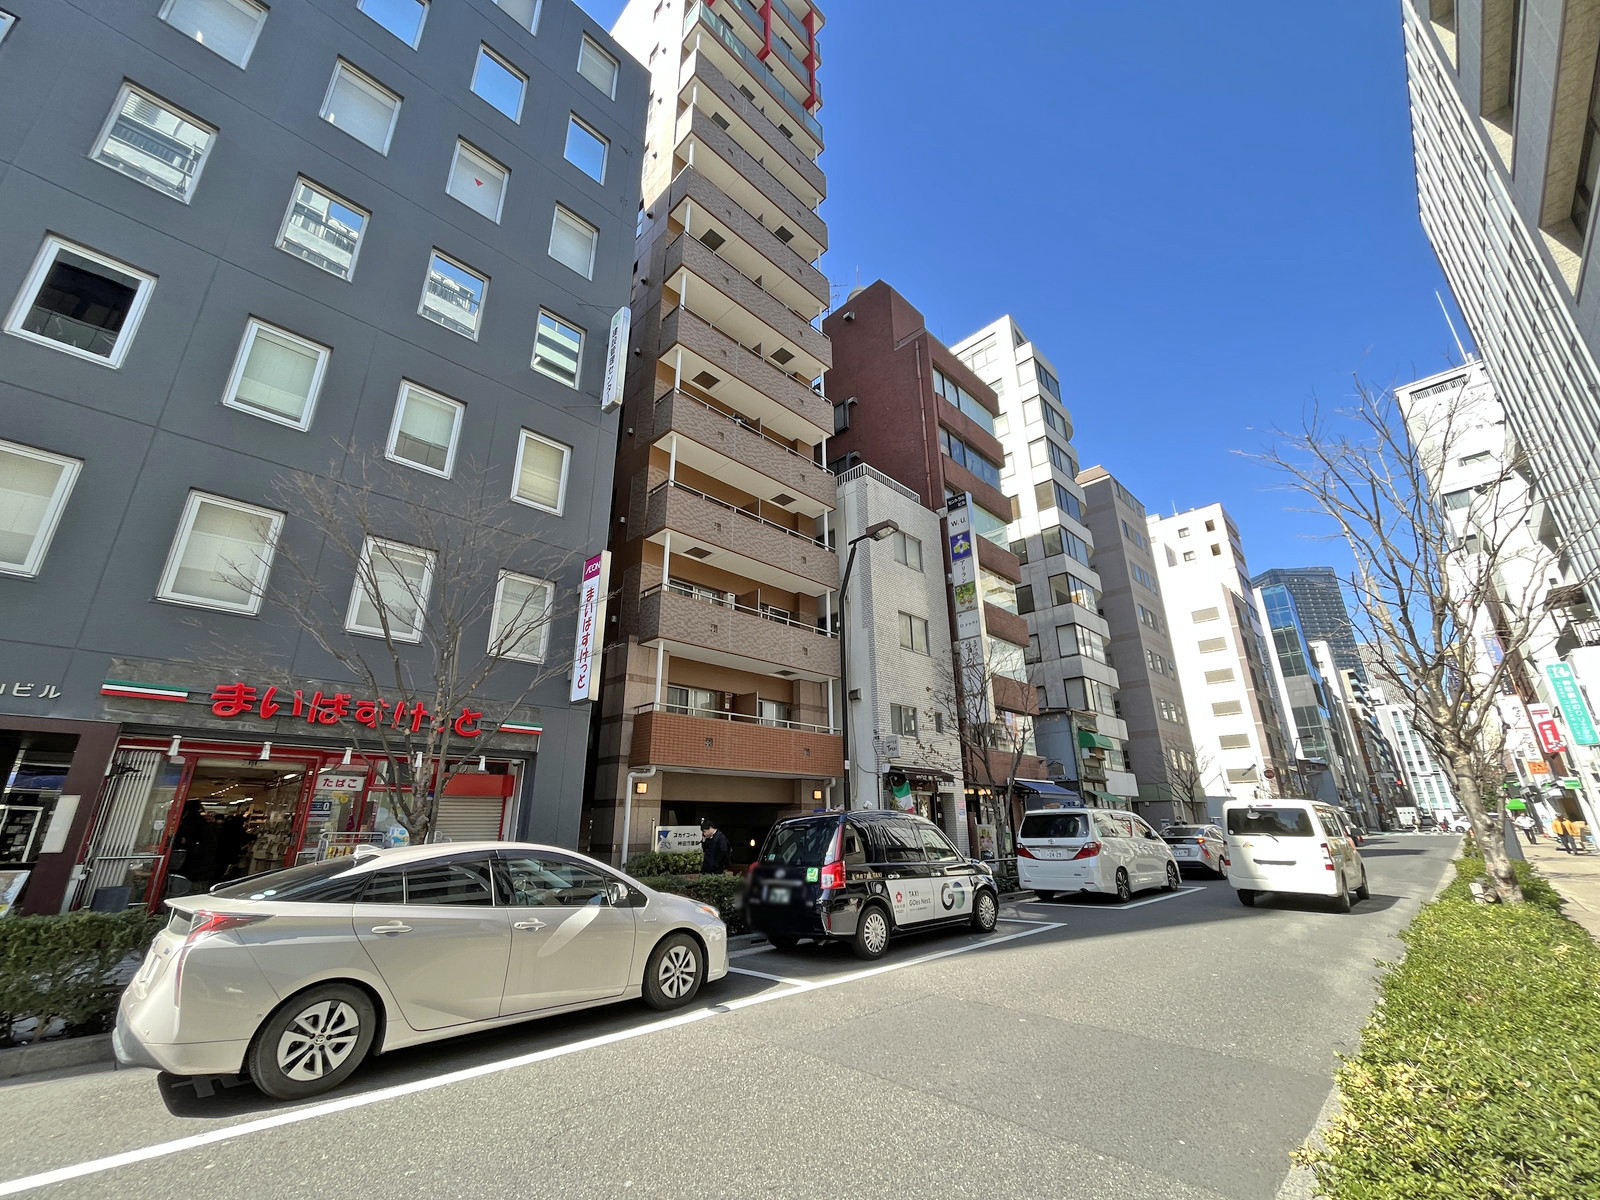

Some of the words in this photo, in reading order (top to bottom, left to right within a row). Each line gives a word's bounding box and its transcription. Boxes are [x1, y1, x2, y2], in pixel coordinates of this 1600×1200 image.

[577, 586, 595, 689] まいばすけっと
[0, 682, 61, 699] ビル
[322, 778, 358, 788] たばこ
